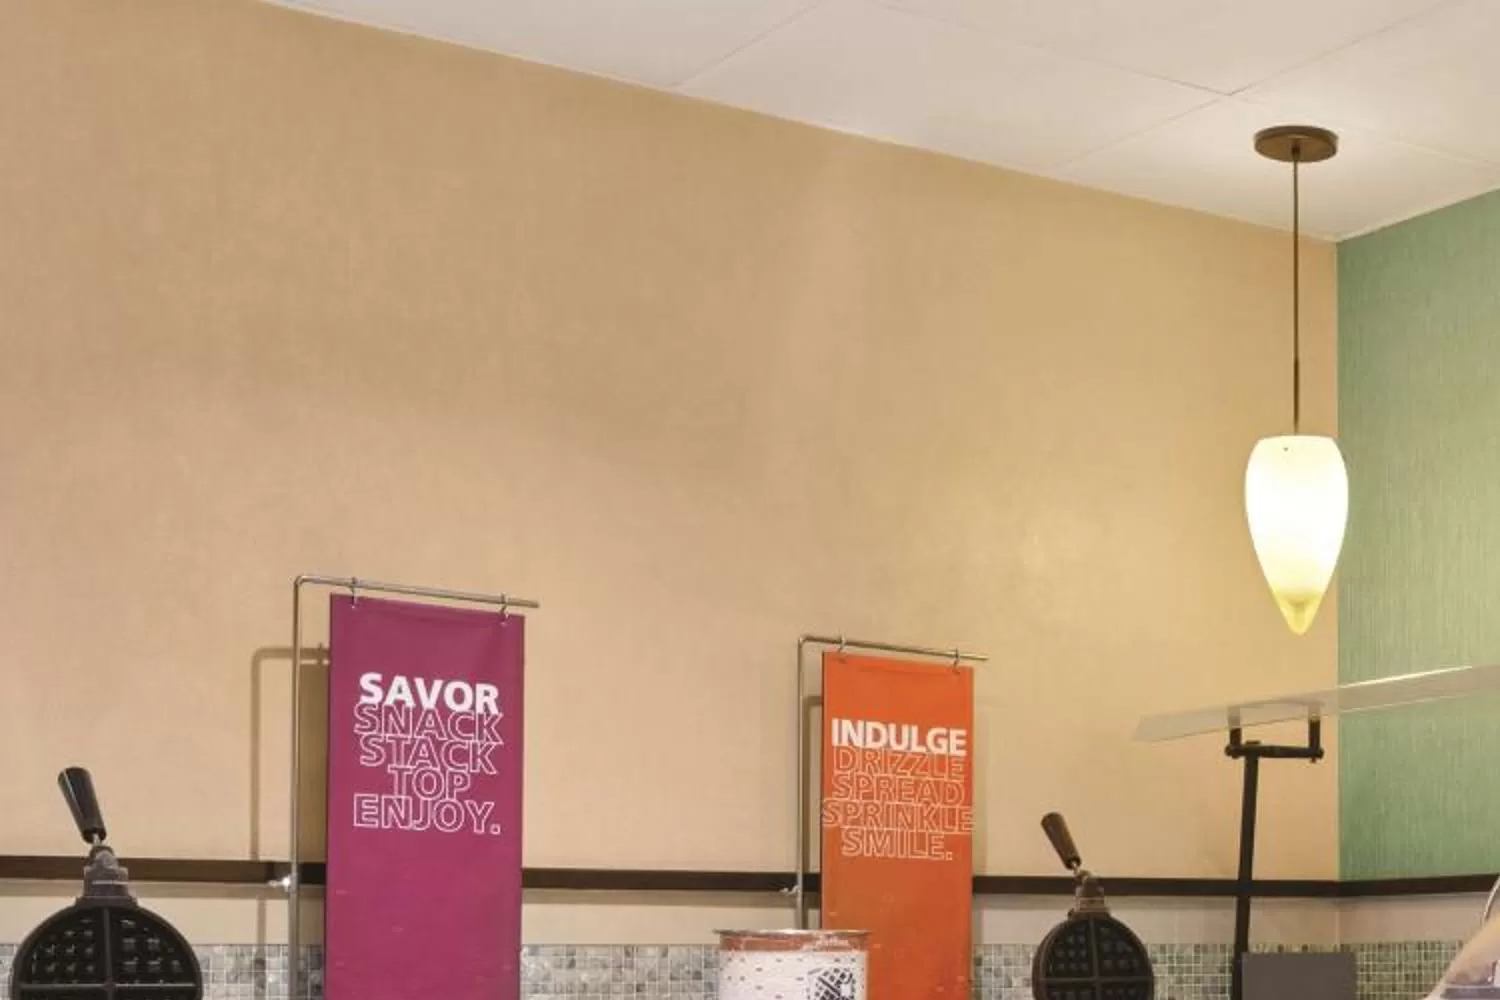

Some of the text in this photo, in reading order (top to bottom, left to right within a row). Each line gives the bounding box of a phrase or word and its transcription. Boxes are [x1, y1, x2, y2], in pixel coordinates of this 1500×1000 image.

[359, 672, 500, 715] SAVOR
[353, 702, 504, 745] SNACK
[831, 718, 968, 756] INDULGE
[359, 733, 497, 774] STACK
[833, 746, 966, 781] DRIZZLE
[387, 765, 470, 801] TOP
[832, 773, 966, 807] SPREAD
[353, 793, 501, 835] ENJOY.
[822, 798, 975, 835] SPRINKLE
[840, 826, 953, 861] SMILE.
